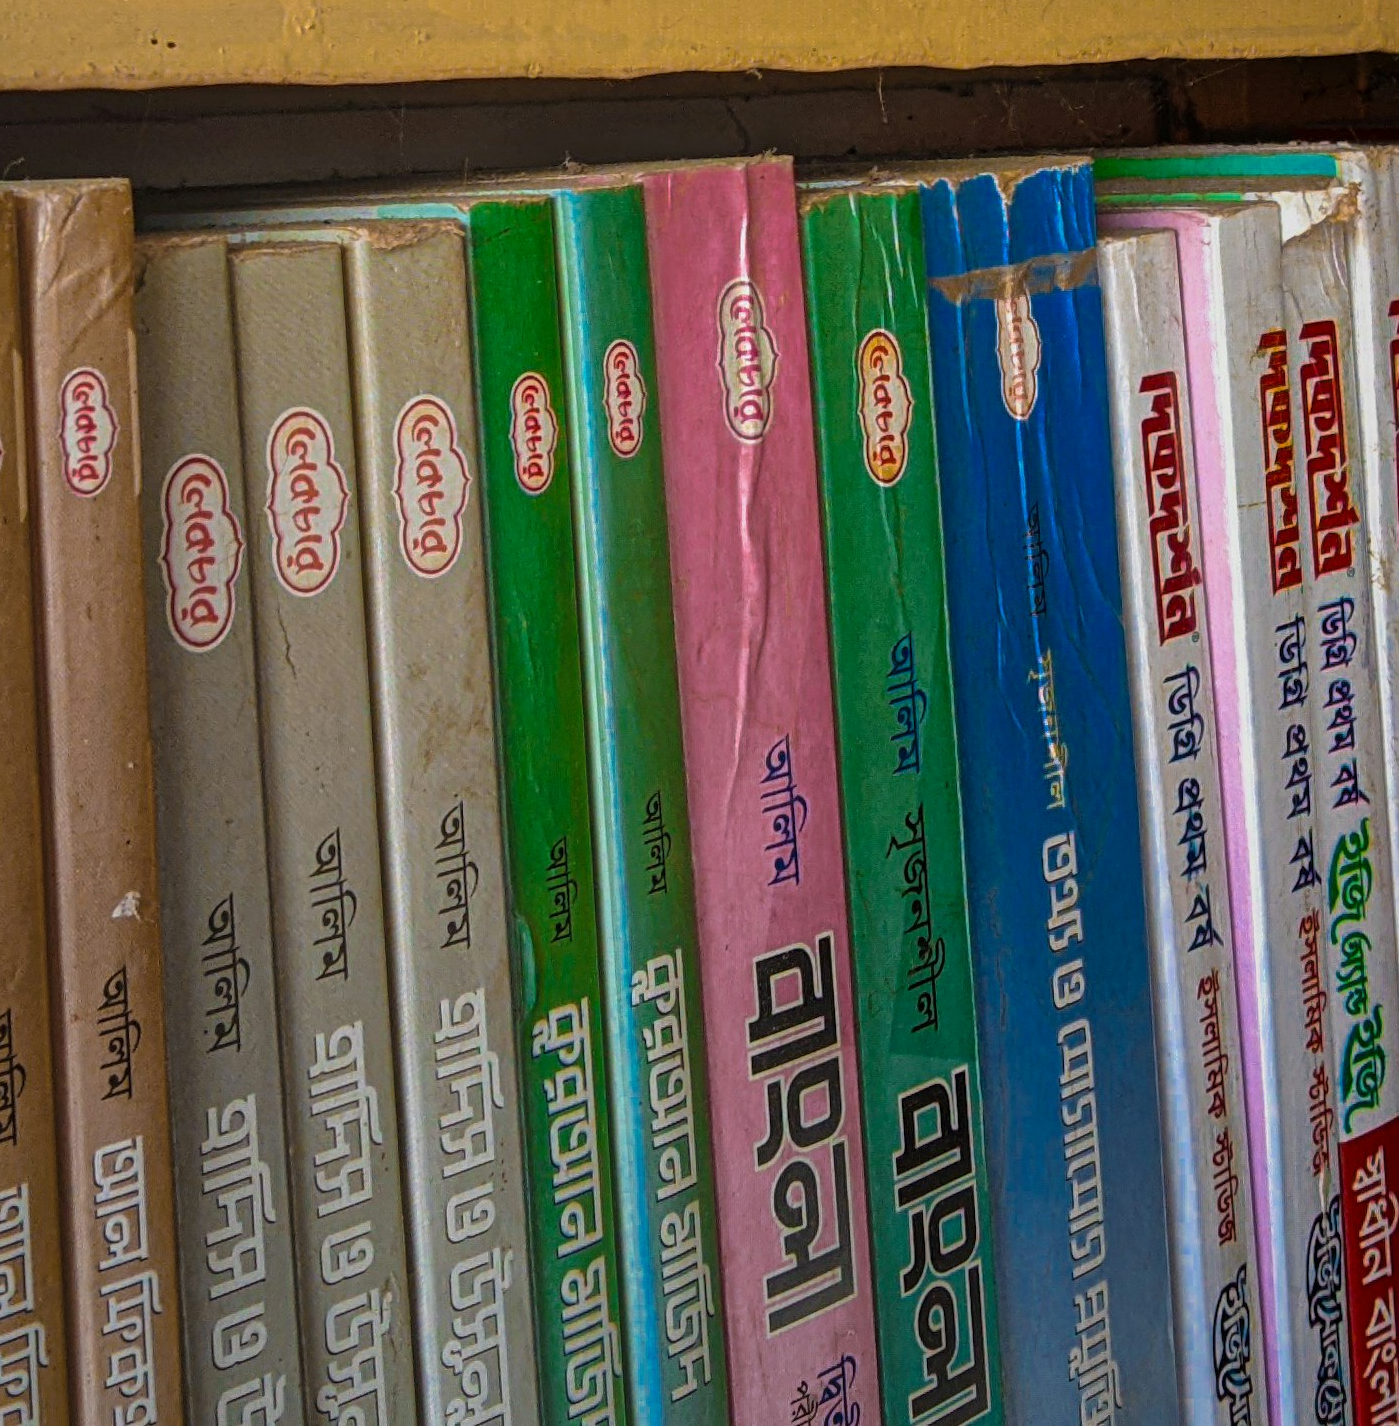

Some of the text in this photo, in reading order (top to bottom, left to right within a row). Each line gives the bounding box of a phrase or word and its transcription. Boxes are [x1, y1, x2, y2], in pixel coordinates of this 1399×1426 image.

[884, 632, 927, 778] আলিম
[640, 790, 672, 899] আলিম
[1331, 760, 1371, 812] বর্ষ
[307, 828, 360, 982] আলিম
[543, 834, 578, 946] আলিম
[1184, 886, 1224, 953] বর্ষ
[199, 893, 252, 1053] আলিম
[1051, 957, 1089, 1007] ও
[740, 734, 859, 1341] আলিম বাংলা
[1196, 969, 1231, 1120] ইসলামিক
[320, 1221, 374, 1285] ও
[892, 1064, 991, 1426] বাংলা
[1350, 1147, 1399, 1285] স্বাধীন
[212, 1302, 268, 1370] ও
